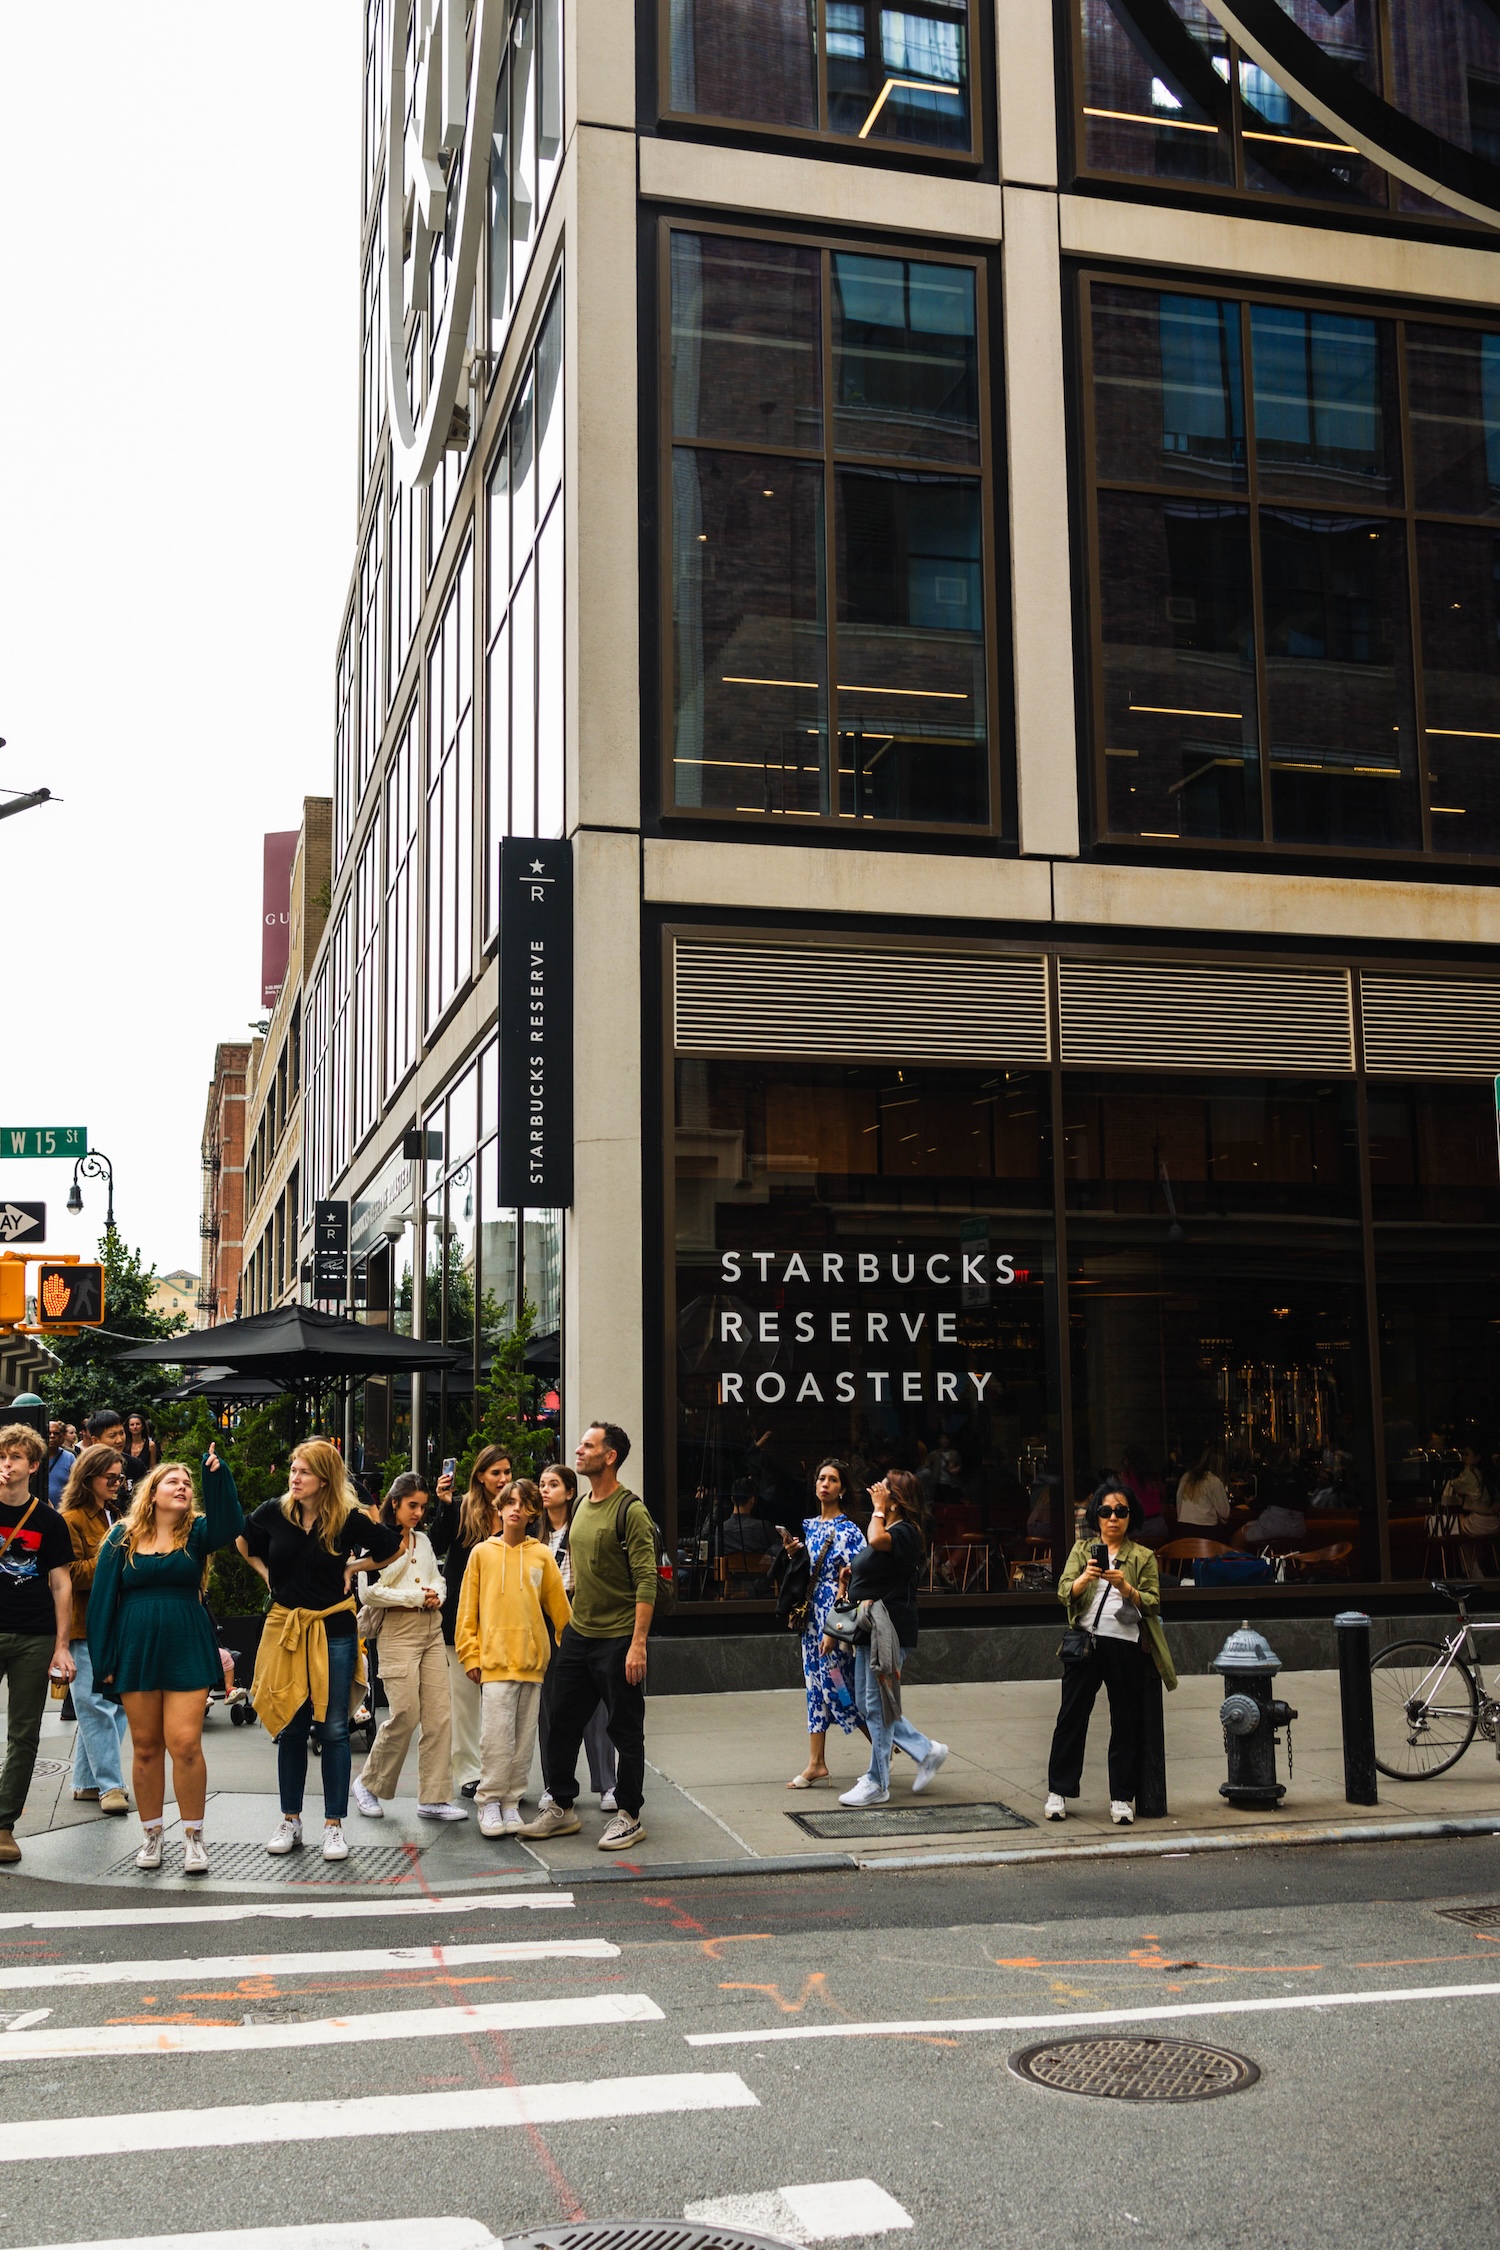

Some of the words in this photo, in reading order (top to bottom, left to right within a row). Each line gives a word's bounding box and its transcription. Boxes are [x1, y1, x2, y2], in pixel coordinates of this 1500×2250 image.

[530, 885, 545, 902] R
[529, 941, 544, 1042] RESERVE
[529, 1056, 544, 1184] STARBUCKS
[11, 1131, 26, 1154] W
[36, 1131, 56, 1154] 15
[66, 1129, 79, 1143] St
[327, 1229, 336, 1239] R
[721, 1251, 1016, 1285] STARBUCKS
[720, 1311, 958, 1343] RESERVE
[721, 1371, 993, 1403] ROASTERY
